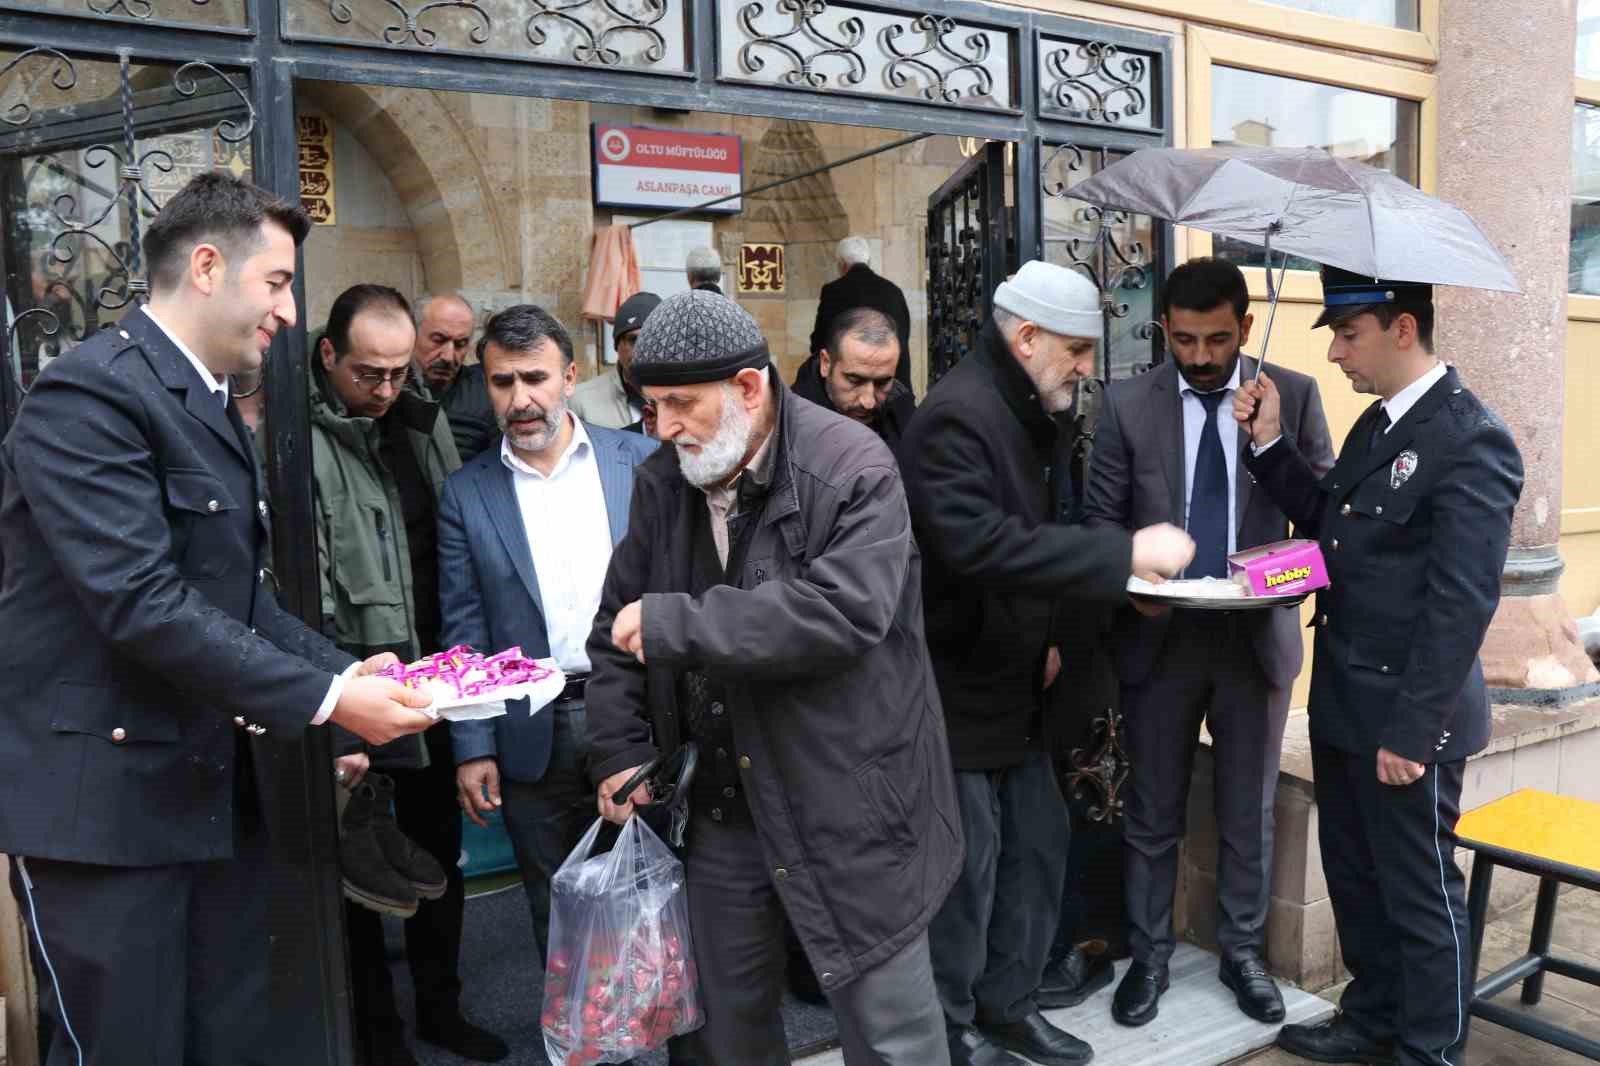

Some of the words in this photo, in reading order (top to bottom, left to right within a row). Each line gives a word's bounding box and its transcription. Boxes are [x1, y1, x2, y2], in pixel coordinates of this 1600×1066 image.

[636, 143, 664, 155] OLTU
[637, 180, 699, 196] ASLANPAŞA
[1264, 566, 1312, 588] hobby
